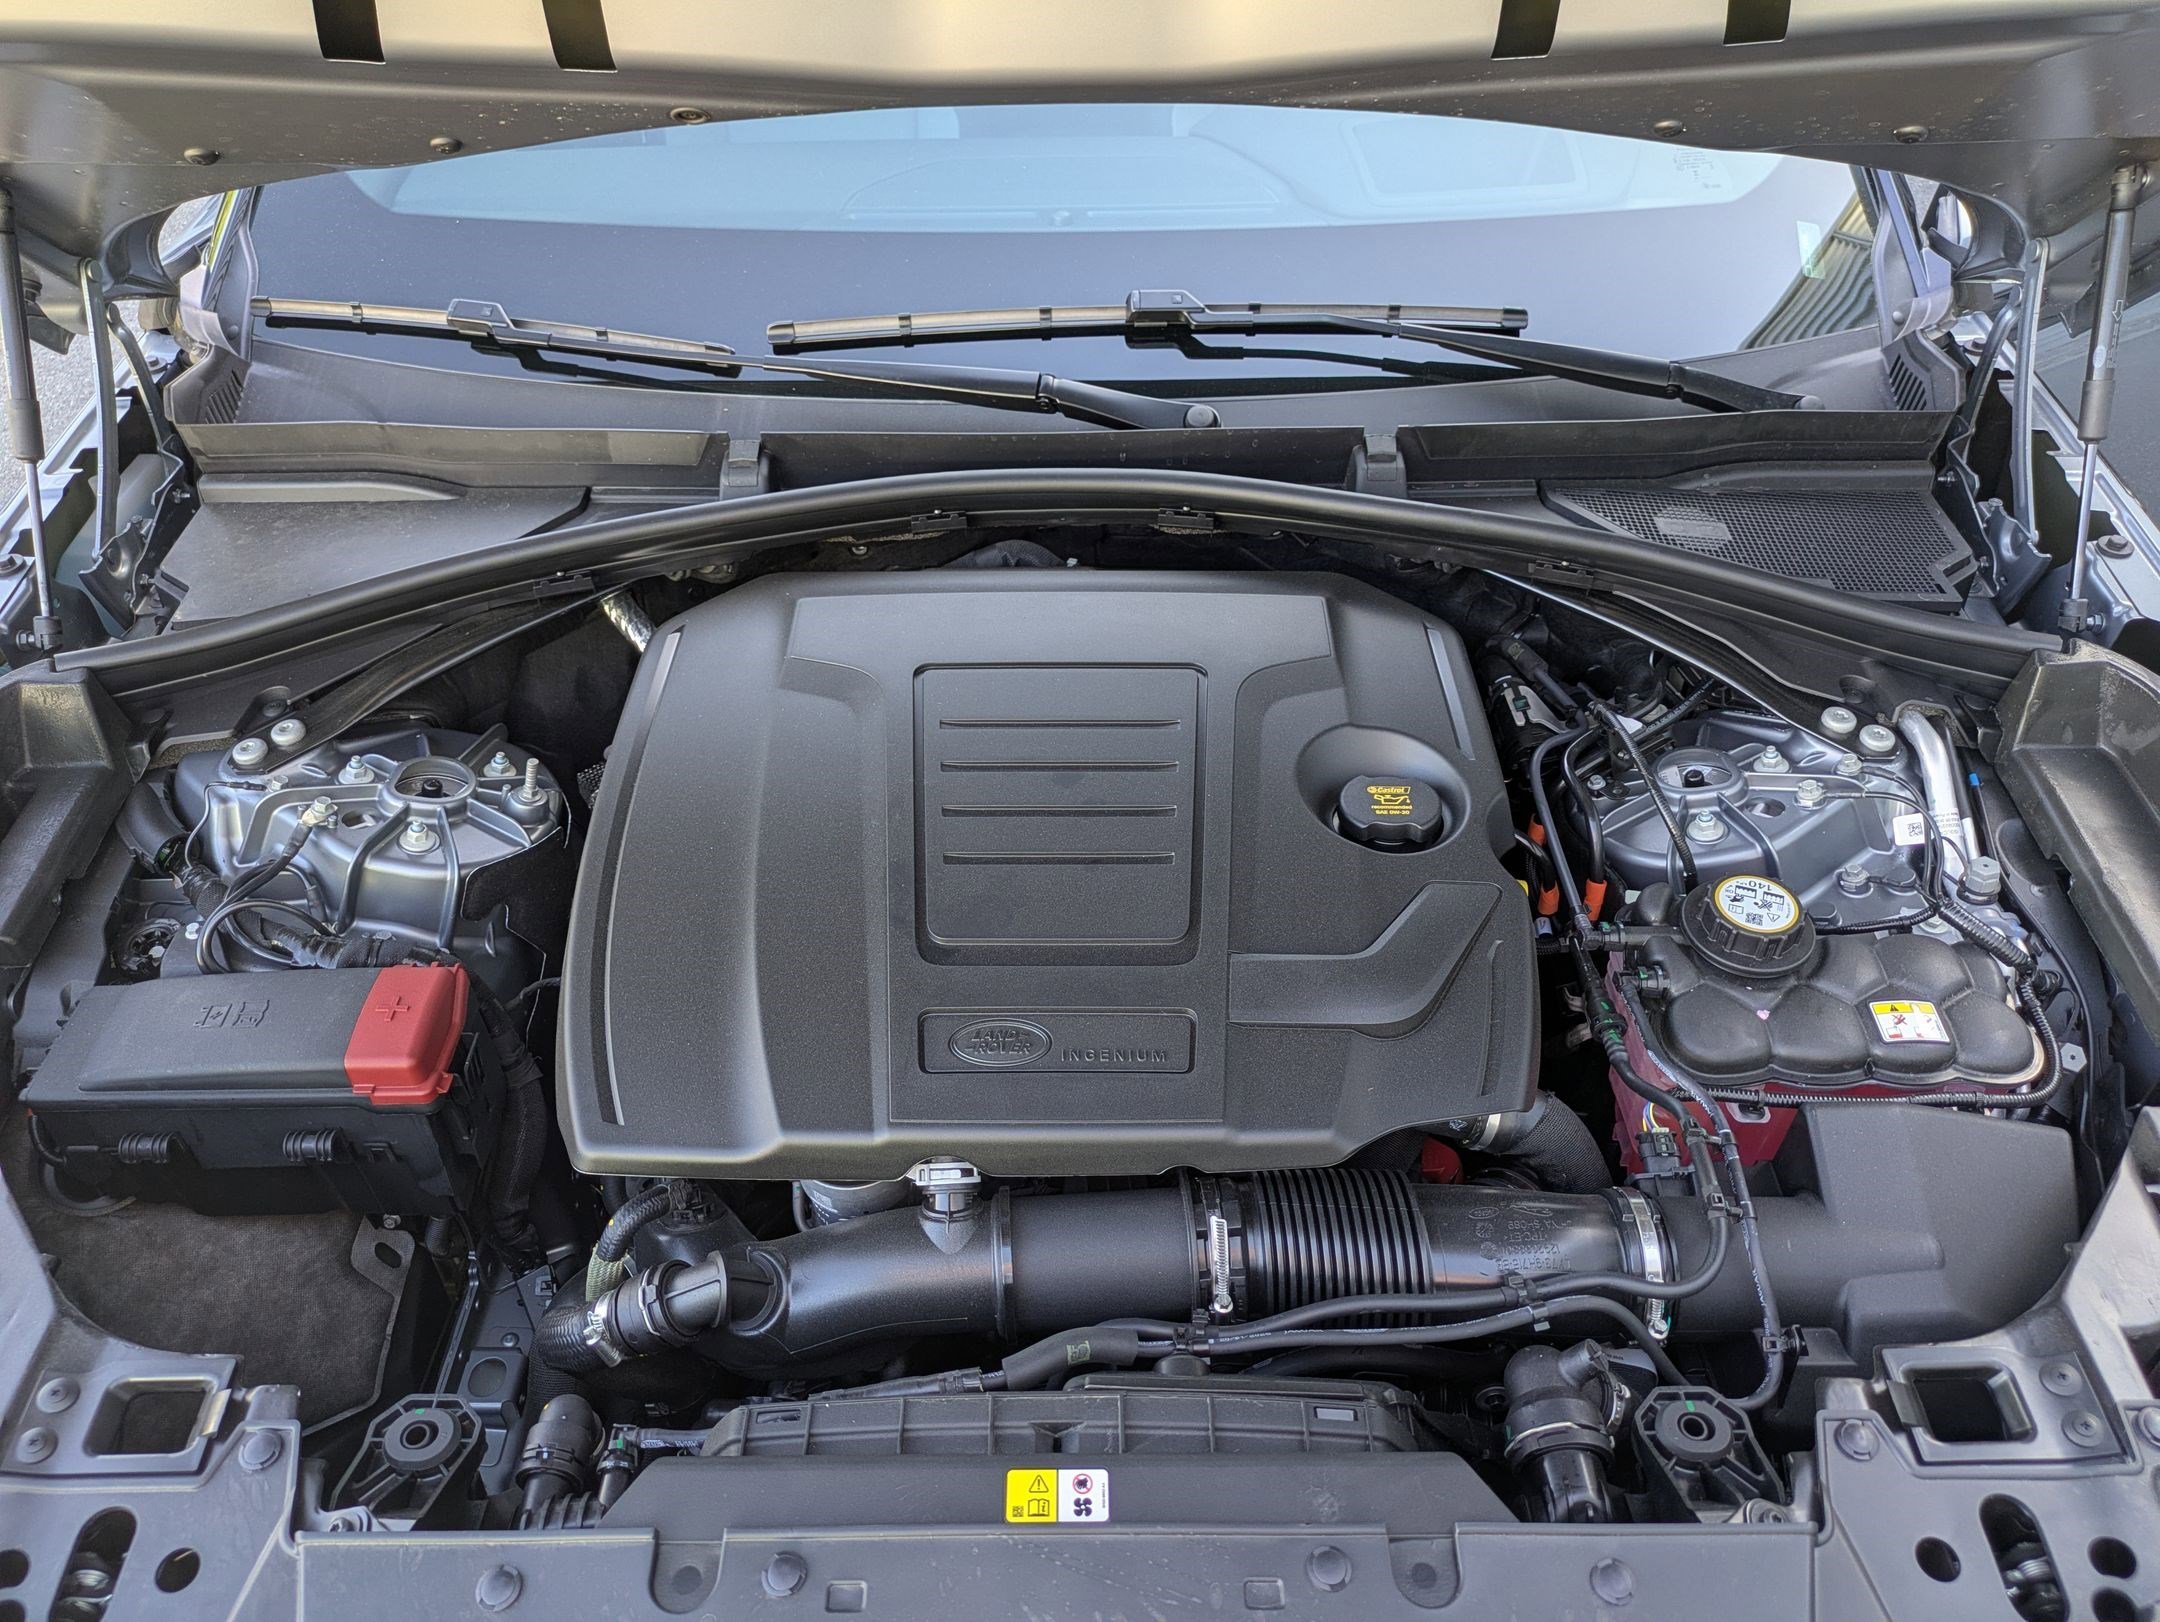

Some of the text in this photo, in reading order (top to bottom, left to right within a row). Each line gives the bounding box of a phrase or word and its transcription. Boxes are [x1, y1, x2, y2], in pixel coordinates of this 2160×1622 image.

[1377, 786, 1405, 794] Castrol
[1748, 880, 1773, 891] 140
[971, 1030, 1017, 1042] LAND
[973, 1041, 1032, 1055] ROVER
[1060, 1049, 1167, 1063] INGENIUM
